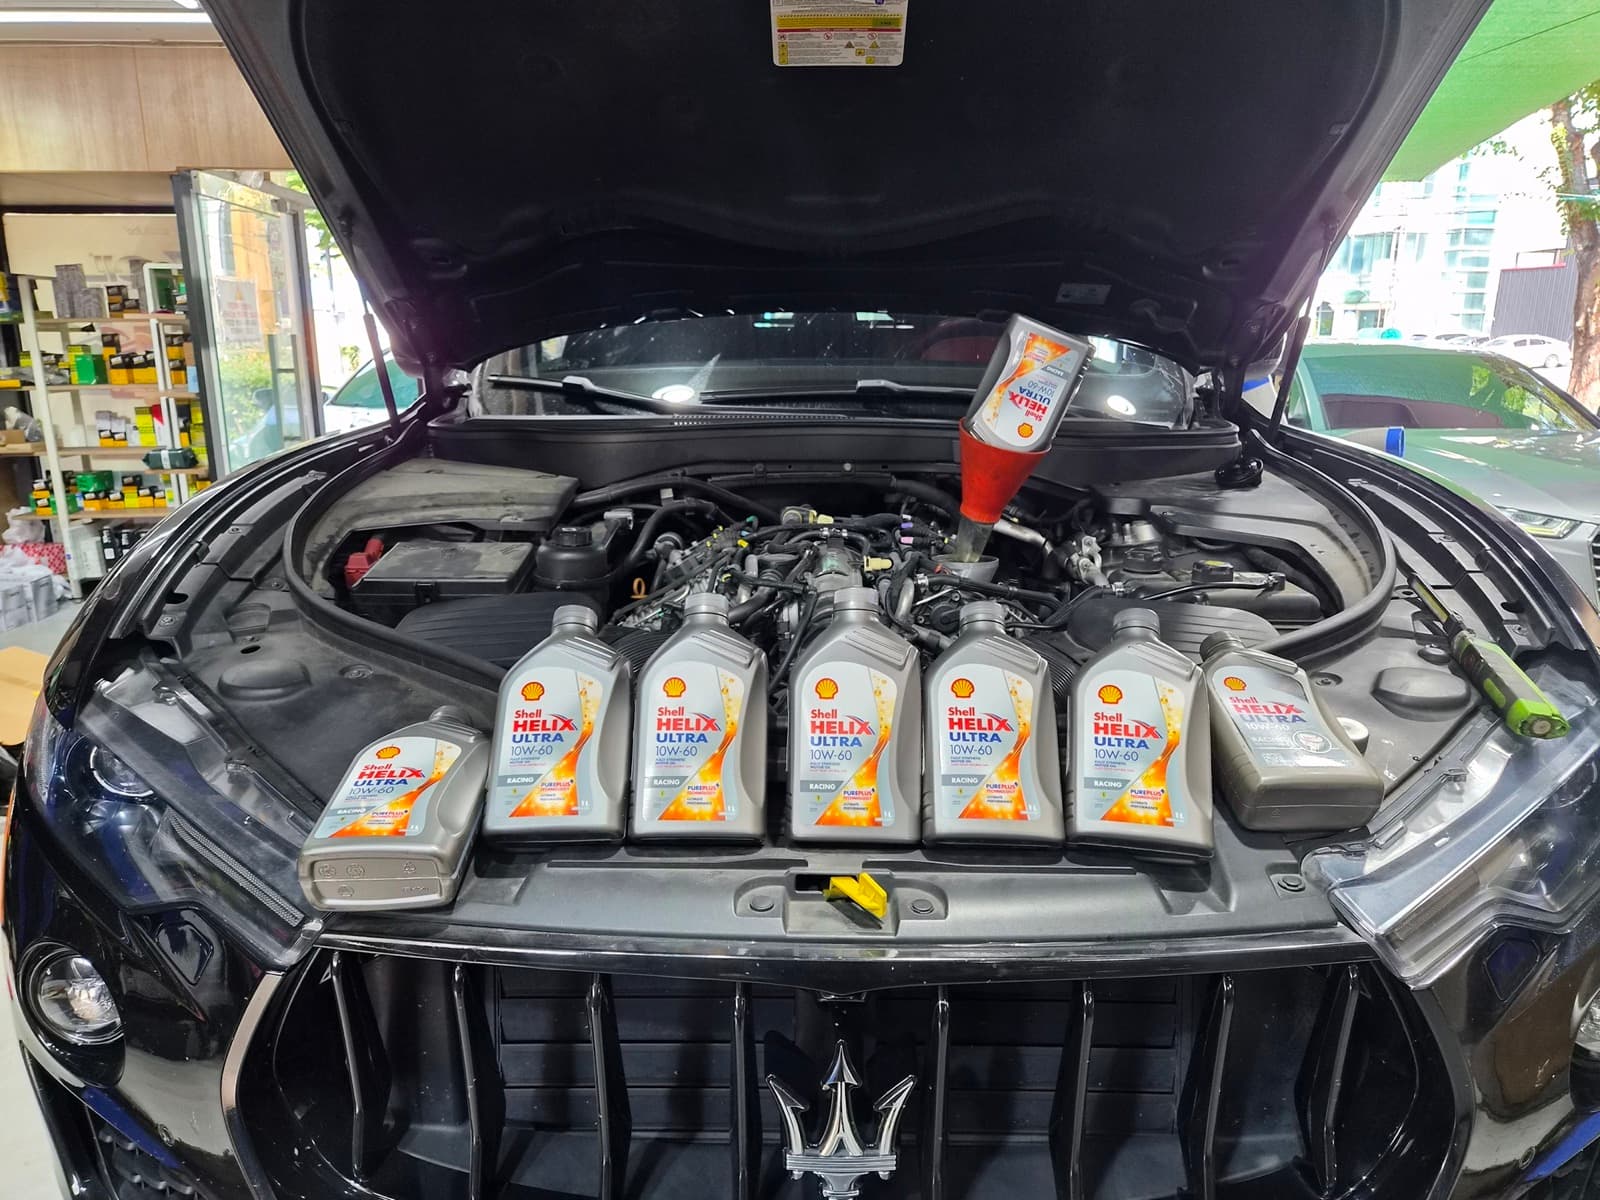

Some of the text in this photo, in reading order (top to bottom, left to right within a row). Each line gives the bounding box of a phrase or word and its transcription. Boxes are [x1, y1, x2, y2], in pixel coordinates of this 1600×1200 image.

[1019, 386, 1051, 405] ULTRA
[1008, 391, 1048, 414] HELIX
[1025, 410, 1043, 421] Shell
[657, 706, 685, 716] Shell
[948, 706, 975, 716] Shell
[1234, 702, 1304, 714] HELIX
[514, 709, 542, 719] Shell
[810, 709, 838, 719] Shell
[1094, 712, 1122, 722] Shell
[1239, 715, 1307, 723] ULTRA
[513, 716, 577, 732] HELIX
[657, 715, 721, 731] HELIX
[810, 717, 875, 735] HELIX
[948, 714, 1014, 731] HELIX
[1094, 721, 1162, 739] HELIX
[512, 733, 564, 743] ULTRA
[656, 733, 708, 743] ULTRA
[810, 736, 862, 747] ULTRA
[949, 732, 1002, 742] ULTRA
[1094, 737, 1150, 749] ULTRA
[512, 745, 553, 756] 10W-60
[656, 746, 697, 757] 10W-60
[810, 750, 852, 760] 10W-60
[950, 745, 992, 755] 10W-60
[1095, 749, 1139, 761] 10W-60
[358, 767, 425, 779] HELIX
[1094, 780, 1122, 788] RACING
[349, 787, 394, 795] 10W-60
